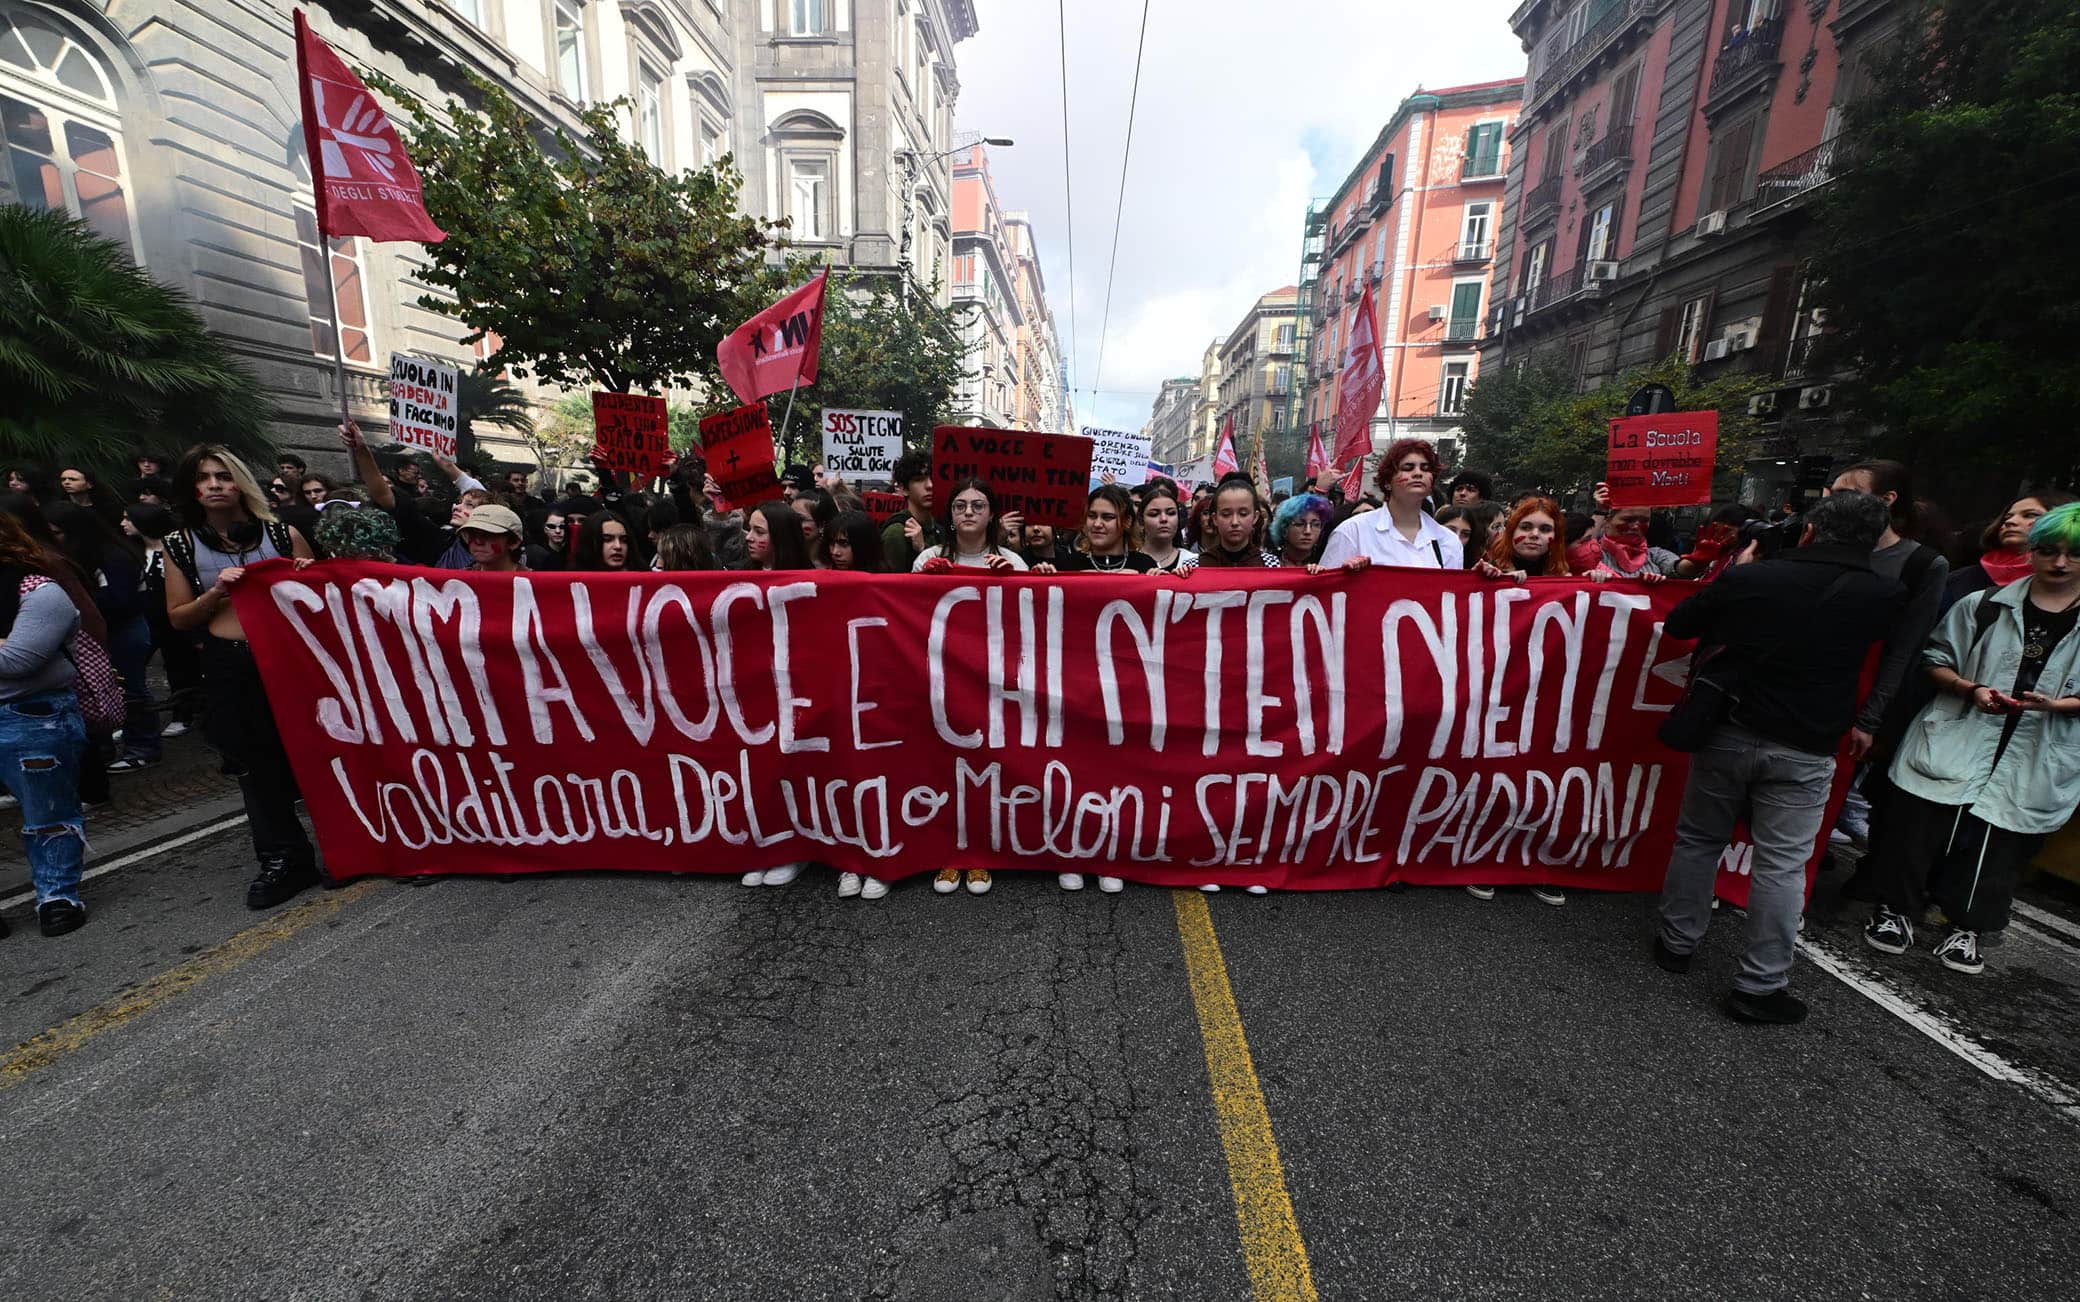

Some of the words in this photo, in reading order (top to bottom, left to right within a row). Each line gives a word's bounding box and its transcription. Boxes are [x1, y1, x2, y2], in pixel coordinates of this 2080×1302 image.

[331, 185, 373, 200] DEGLI
[392, 355, 437, 389] SCUOLA
[441, 372, 453, 393] IN
[825, 413, 902, 437] SOSTEGNO
[1613, 425, 1638, 448] La
[1646, 430, 1701, 447] Scuola
[600, 425, 644, 449] STATO
[833, 433, 864, 445] ALLA
[942, 434, 959, 452] A
[968, 436, 1023, 456] VOCE
[1043, 443, 1053, 459] E
[1093, 439, 1140, 451] LORENZO
[607, 448, 650, 472] COMA
[848, 446, 884, 457] SALUTE
[1642, 452, 1702, 469] dovrebbe
[939, 463, 978, 481] CHI
[1045, 469, 1085, 486] TEN
[1090, 465, 1127, 475] STATO
[271, 577, 507, 747] SIMM
[513, 576, 595, 745] A
[571, 582, 830, 753] VOCE
[848, 616, 903, 751] E
[927, 585, 1064, 749] CHI
[901, 785, 949, 826] o
[956, 757, 1173, 862] Meloni
[1190, 766, 1406, 866] SEMPRE
